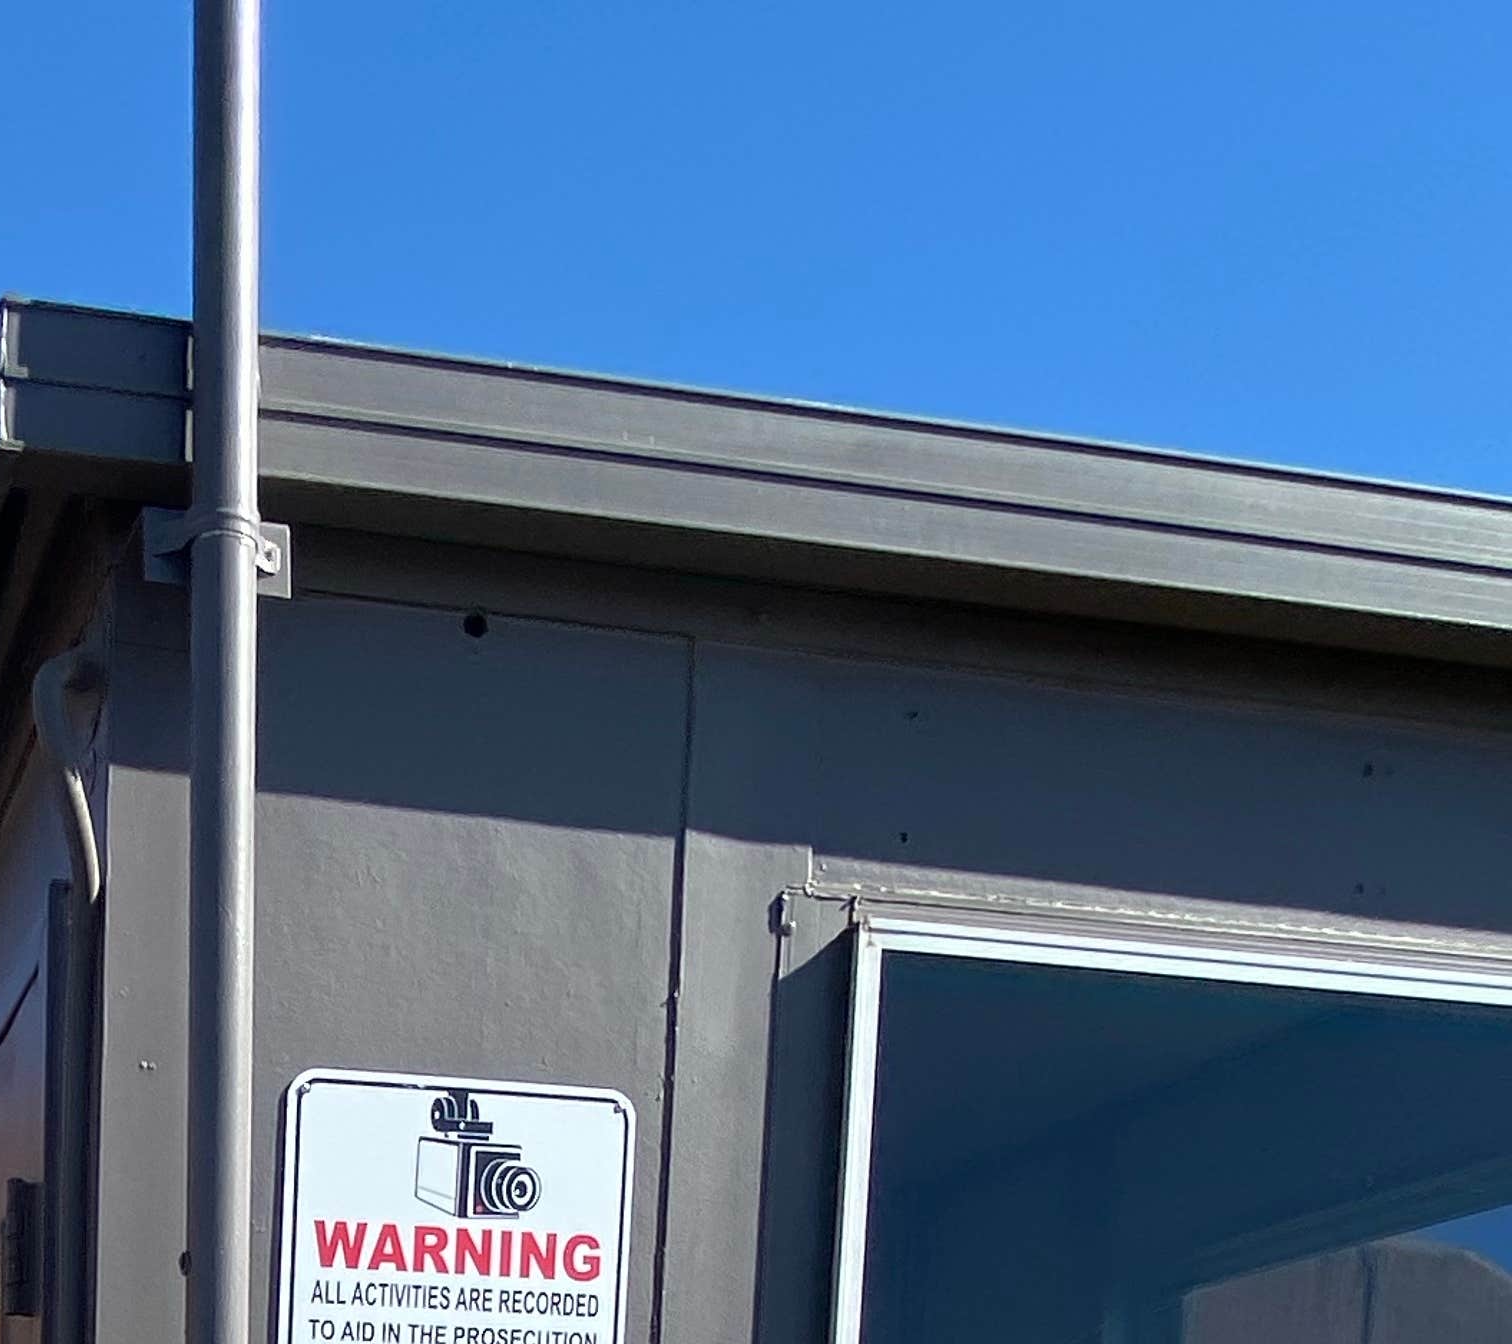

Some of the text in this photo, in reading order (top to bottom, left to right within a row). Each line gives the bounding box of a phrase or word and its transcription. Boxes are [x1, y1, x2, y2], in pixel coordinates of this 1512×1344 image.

[313, 1220, 602, 1281] WARNING
[311, 1280, 599, 1317] ALL ACTIVITIES ARE RECORDED
[308, 1319, 335, 1340] TO
[340, 1321, 374, 1342] AID
[382, 1323, 400, 1344] IN
